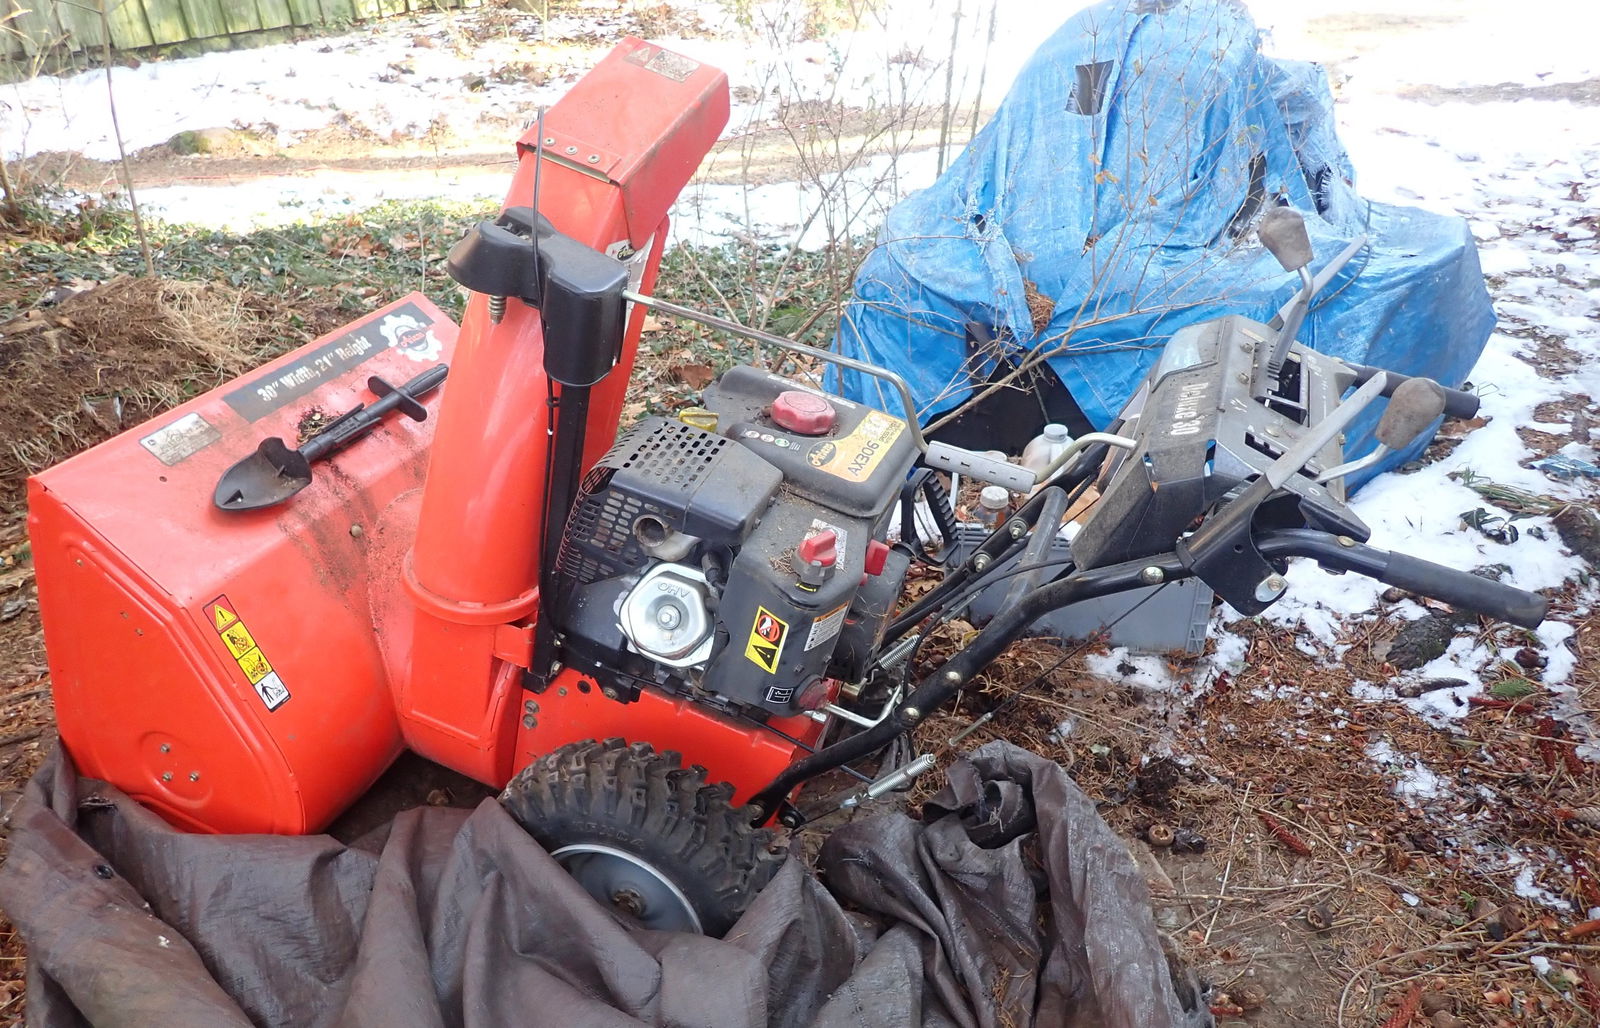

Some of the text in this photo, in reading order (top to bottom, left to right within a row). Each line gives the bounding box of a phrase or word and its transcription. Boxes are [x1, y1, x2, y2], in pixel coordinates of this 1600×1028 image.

[280, 365, 321, 390] Width,
[335, 335, 373, 361] Height
[1170, 382, 1209, 436] Deluxe 30
[847, 440, 880, 476] AX306
[657, 582, 691, 598] OHV
